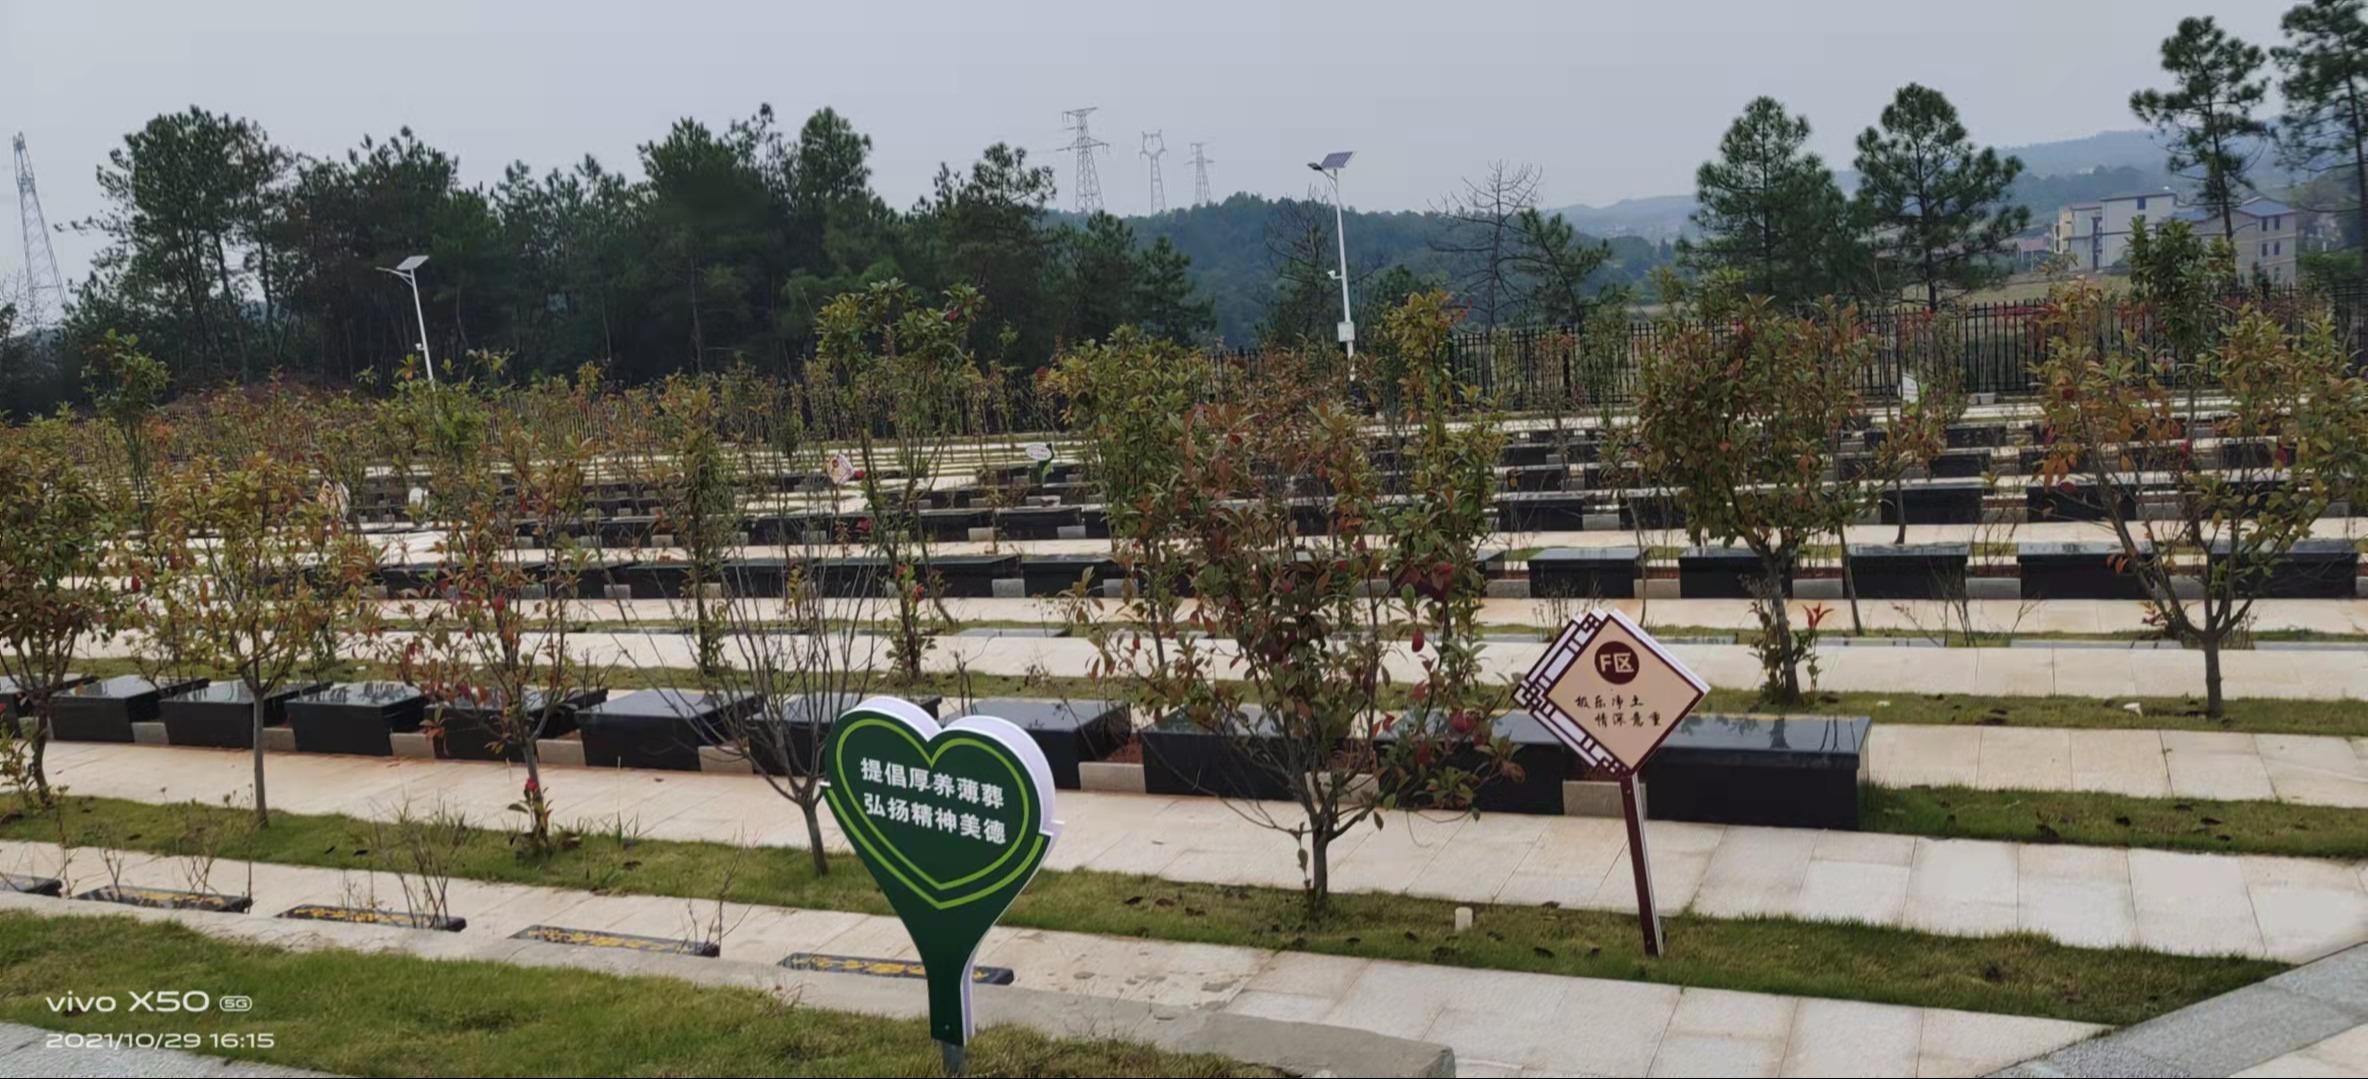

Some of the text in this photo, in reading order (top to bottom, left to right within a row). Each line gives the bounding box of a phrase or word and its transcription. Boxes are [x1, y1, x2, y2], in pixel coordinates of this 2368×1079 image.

[1600, 652, 1634, 673] F区
[1594, 711, 1662, 728] 情深意重
[860, 757, 1005, 810] 提倡厚养薄葬
[863, 792, 1007, 845] 弘扬精神美德
